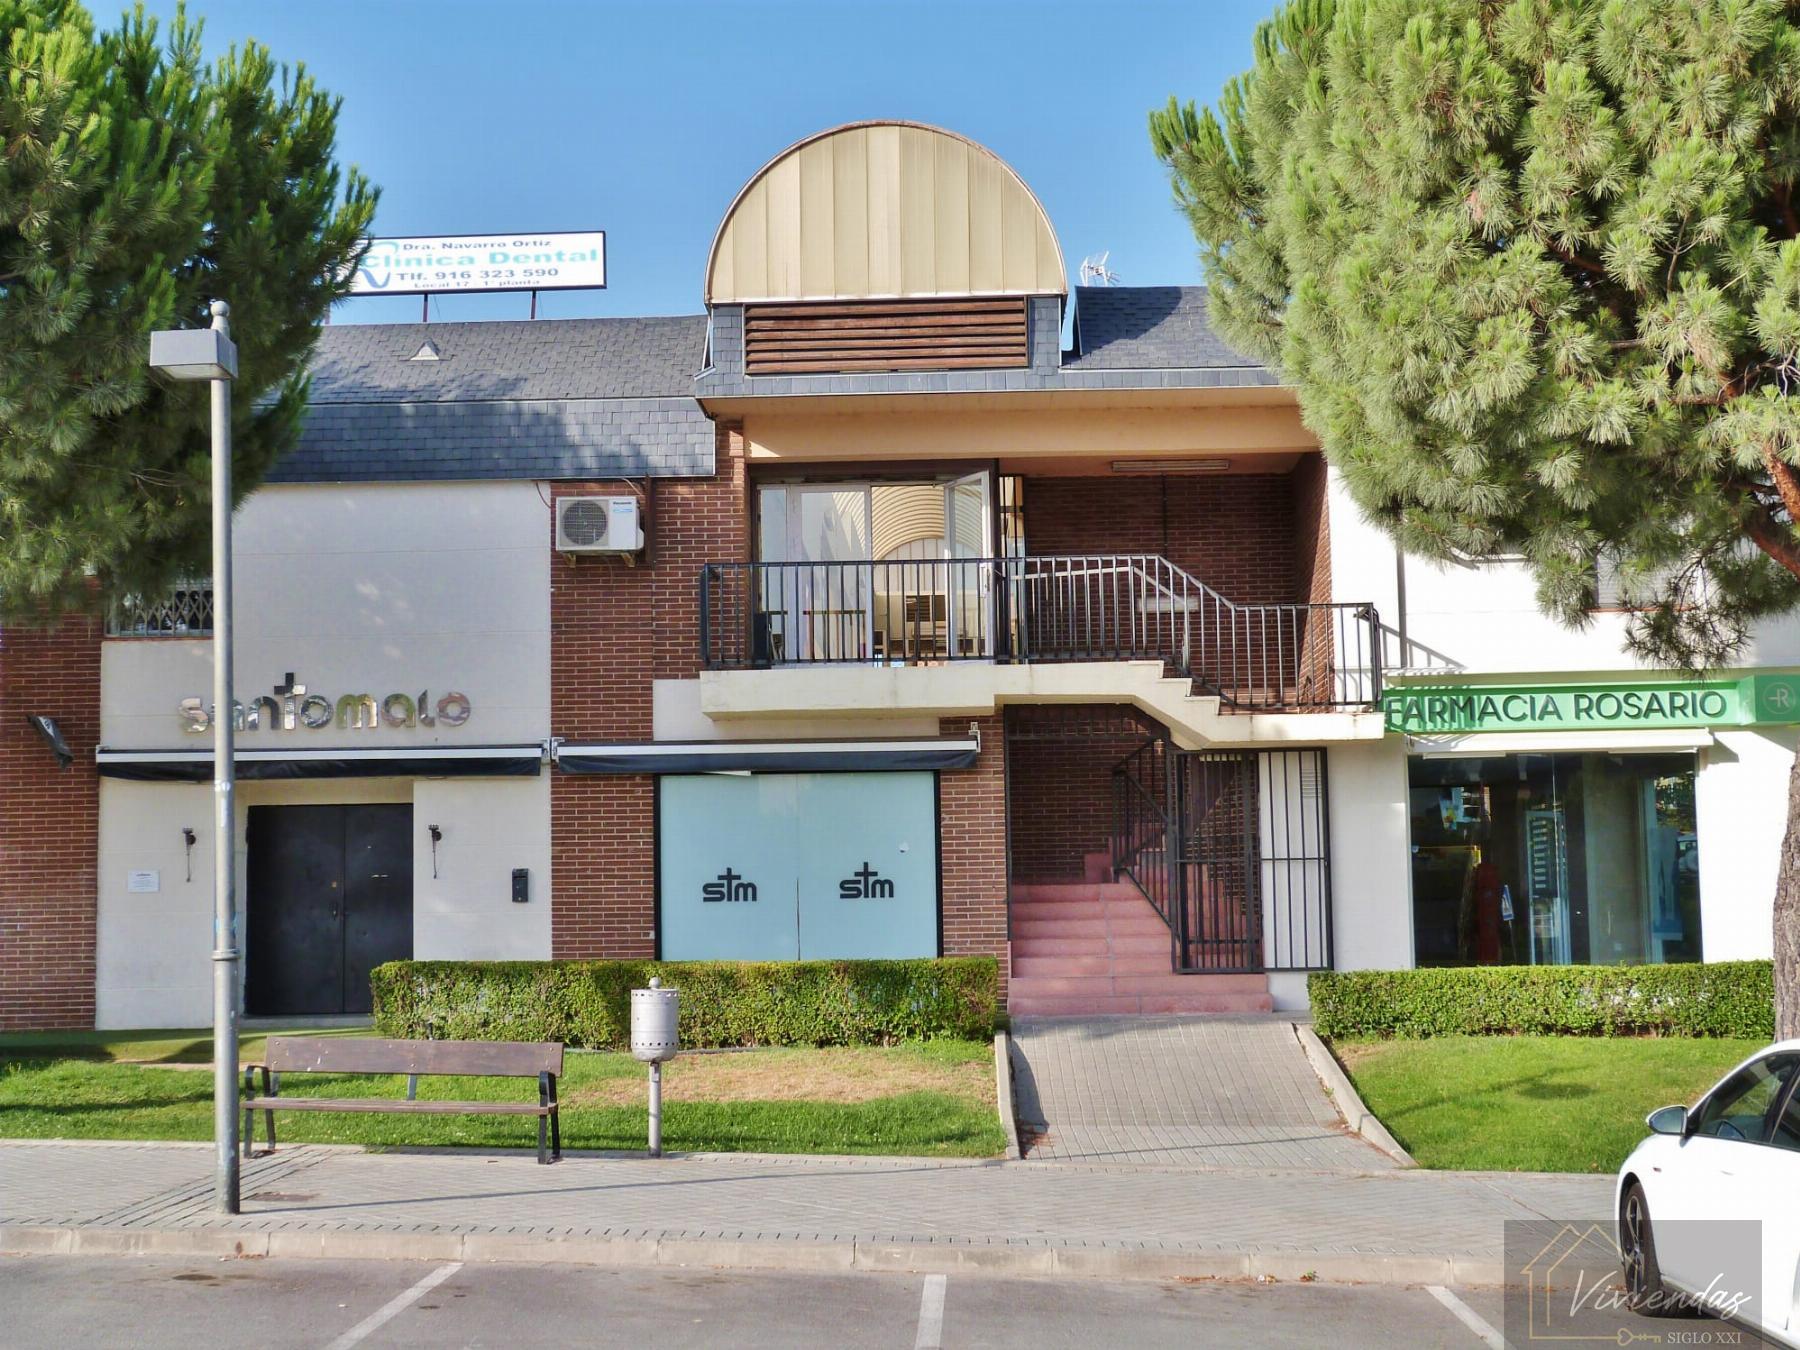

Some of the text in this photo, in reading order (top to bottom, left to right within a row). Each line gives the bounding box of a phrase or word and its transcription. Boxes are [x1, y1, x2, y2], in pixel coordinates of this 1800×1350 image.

[403, 239, 552, 251] Dra. Navarro Ortiz
[488, 248, 598, 265] Dental
[435, 271, 472, 280] 916
[479, 269, 515, 278] 323
[522, 267, 559, 277] 590
[1385, 691, 1728, 724] FARMACIA ROSARIO
